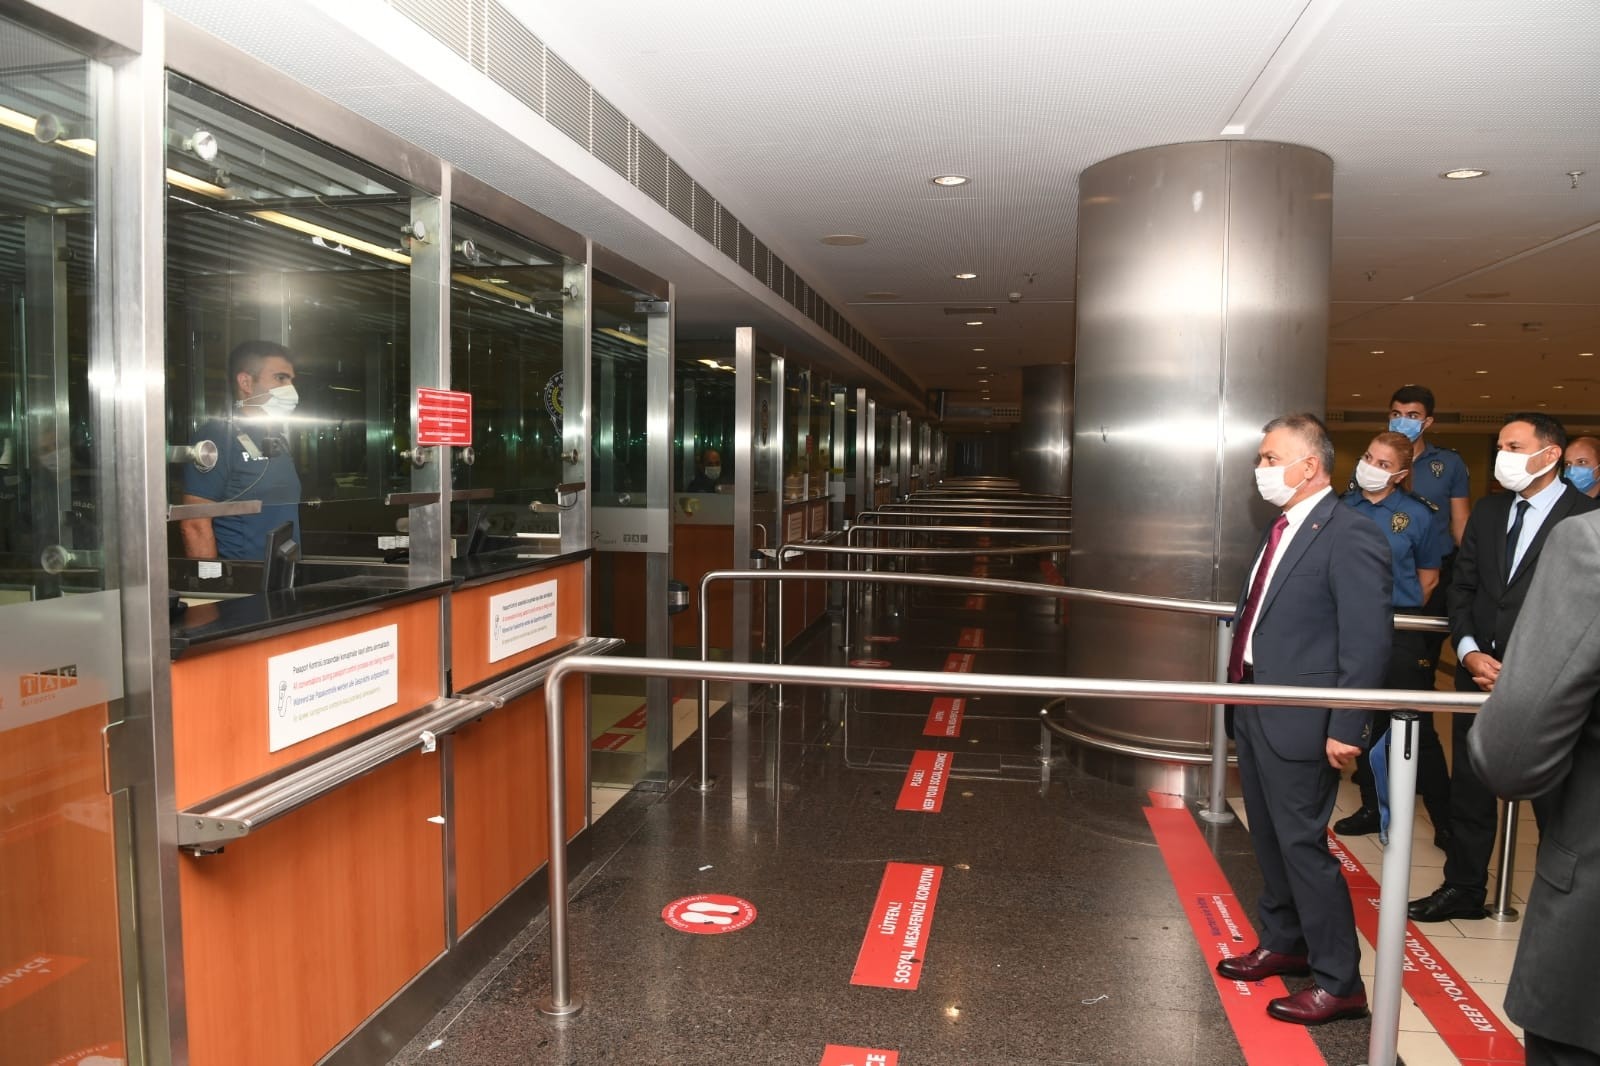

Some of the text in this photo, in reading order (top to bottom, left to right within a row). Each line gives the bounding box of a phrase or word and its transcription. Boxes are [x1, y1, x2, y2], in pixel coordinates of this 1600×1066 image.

[623, 534, 648, 544] TA
[923, 798, 935, 811] KEEP
[893, 867, 935, 984] SOSYAL MESAFENİZİ KORUYUN
[1405, 938, 1442, 971] SOCIAL
[1431, 972, 1469, 1002] YOUR
[1459, 1004, 1497, 1032] KEEP
